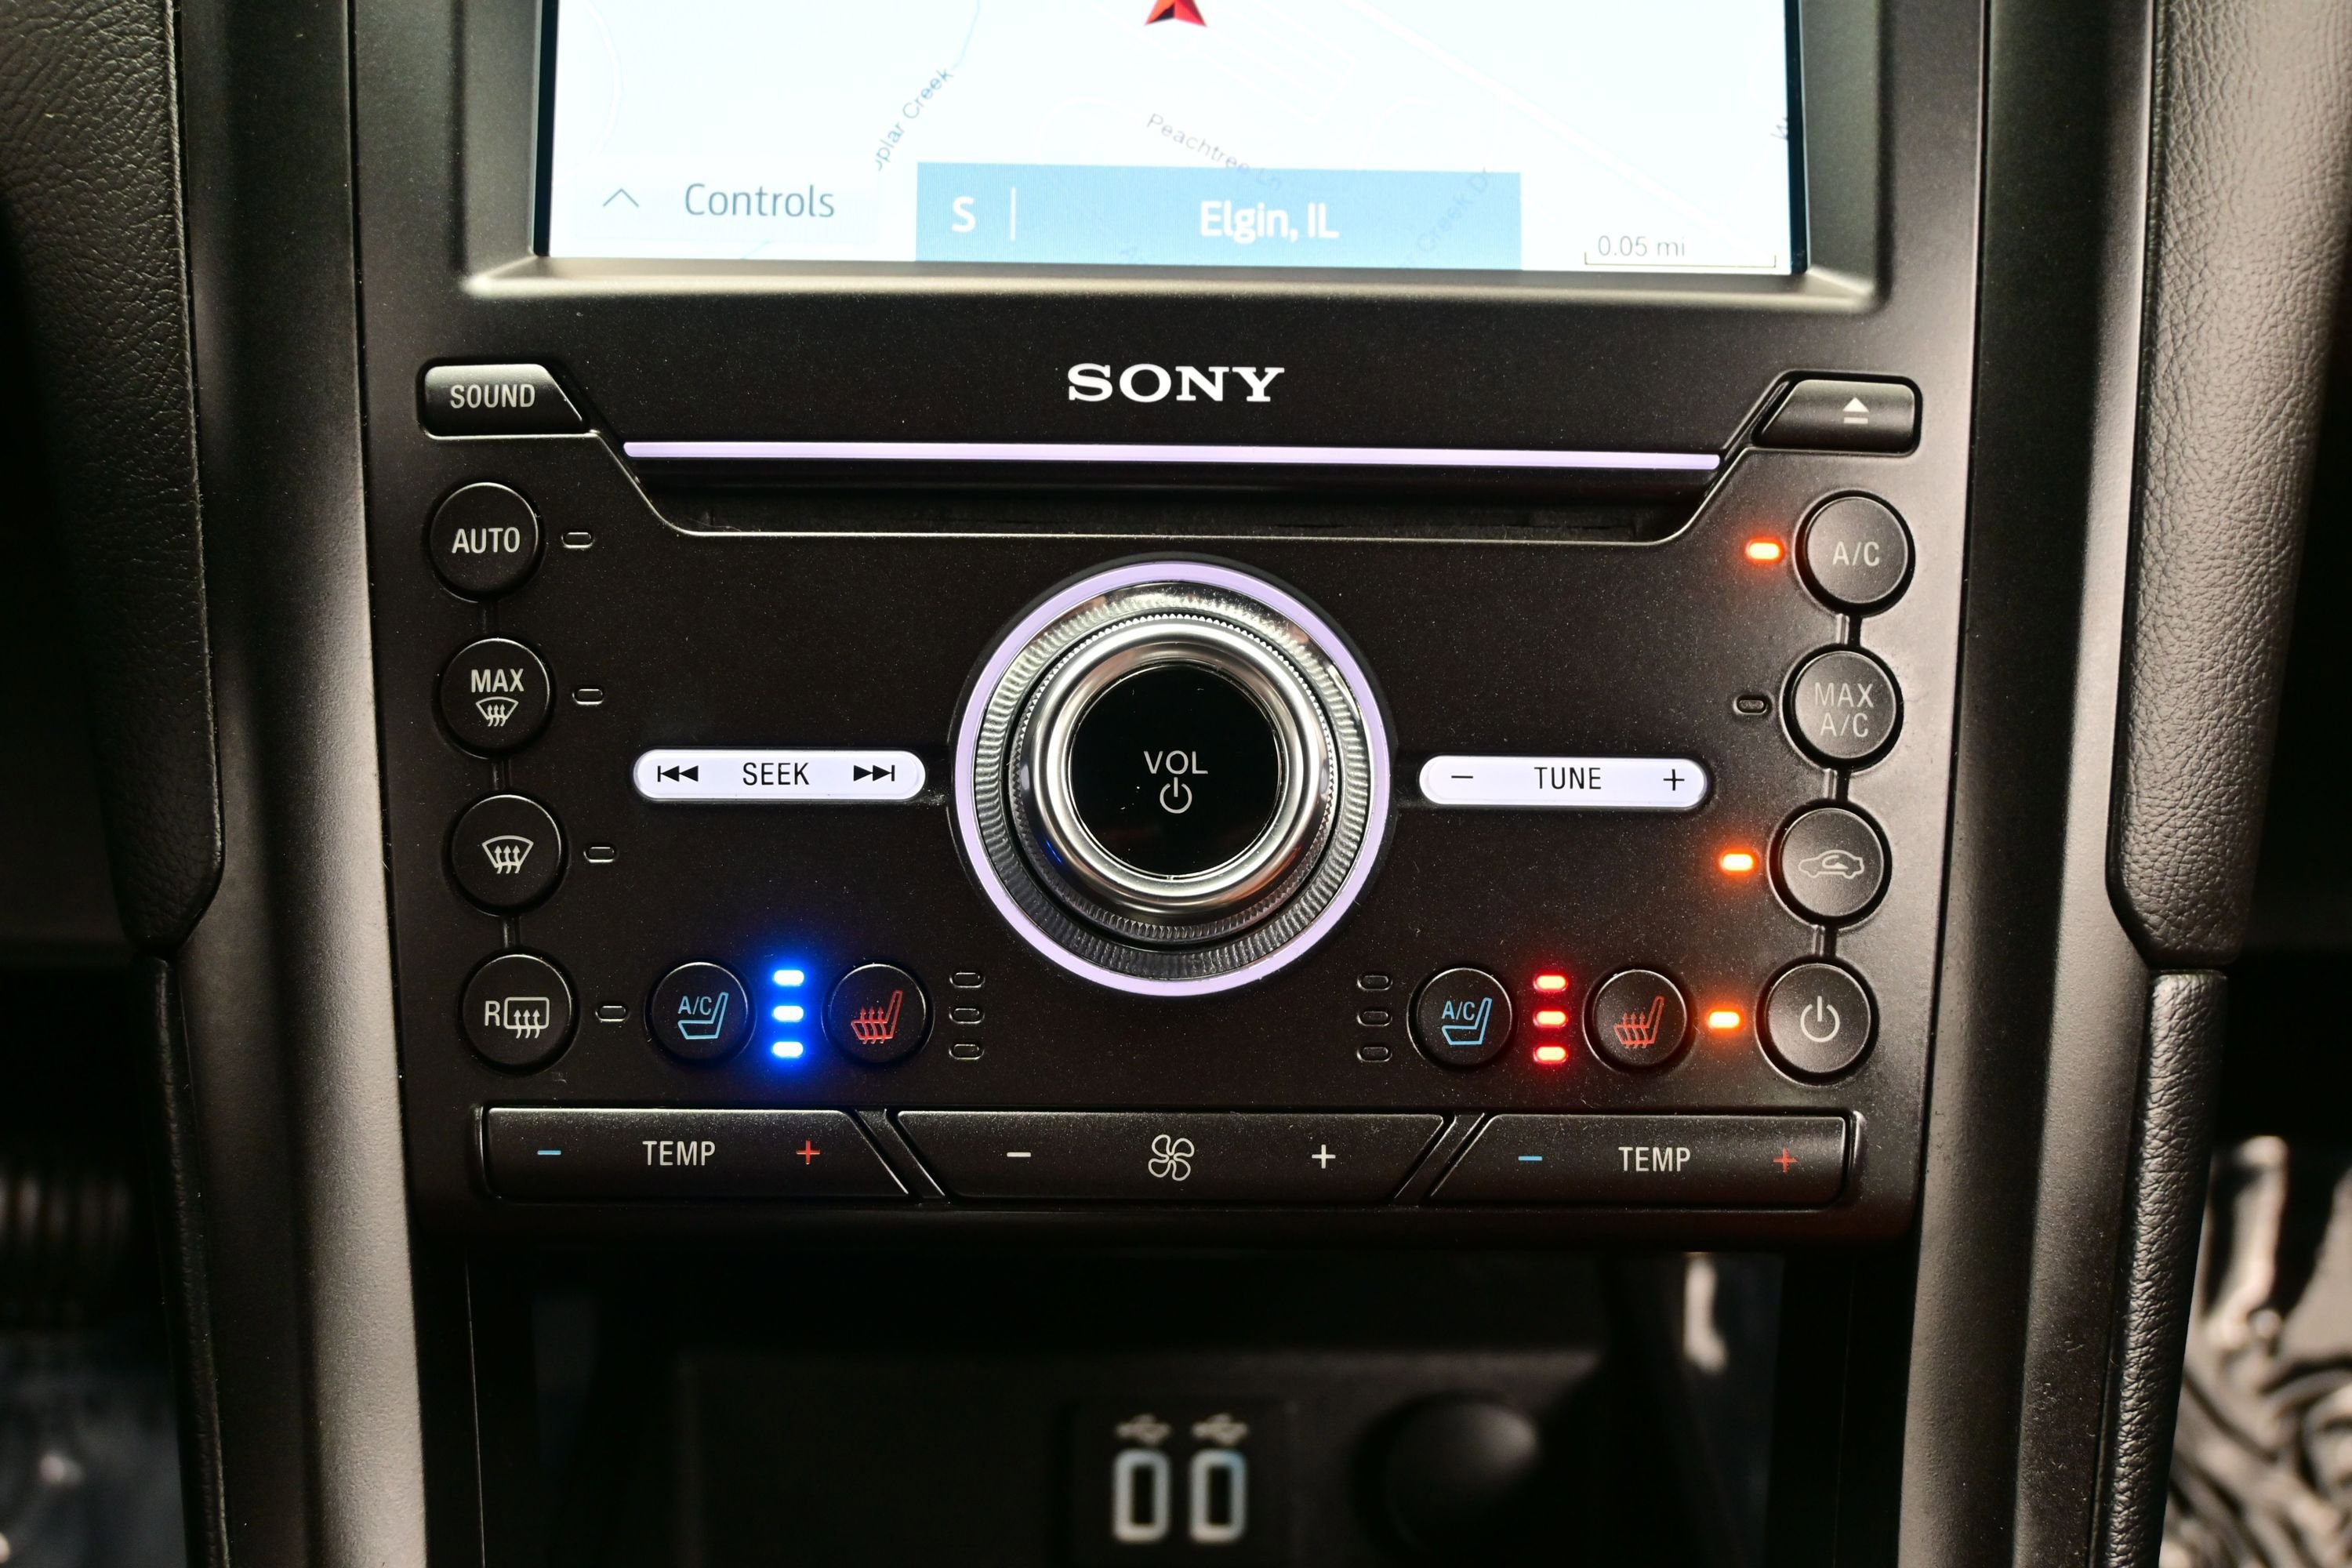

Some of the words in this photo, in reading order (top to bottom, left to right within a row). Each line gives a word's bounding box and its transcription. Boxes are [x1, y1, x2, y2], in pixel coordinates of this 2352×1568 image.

[902, 67, 955, 119] Creek
[1146, 112, 1251, 174] Peachtree
[684, 183, 835, 218] Controls
[951, 196, 977, 233] S
[1200, 199, 1299, 245] Elgin,
[1307, 201, 1341, 239] IL
[1597, 234, 1648, 257] 0.05
[1656, 235, 1686, 257] mi
[449, 383, 536, 409] SOUND
[1067, 362, 1285, 403] SONY
[451, 527, 521, 554] AUTO
[1831, 540, 1881, 567] A/C
[471, 668, 524, 693] MAX
[1813, 681, 1875, 709] MAX
[1820, 712, 1870, 739] A/C
[742, 762, 810, 786] SEEK
[1143, 750, 1209, 775] VOL
[1534, 766, 1602, 790] TUNE
[485, 1000, 501, 1027] R
[677, 996, 712, 1015] A/C
[1442, 1000, 1475, 1021] A/C
[642, 1140, 716, 1167] TEMP
[1617, 1146, 1691, 1172] TEMP
